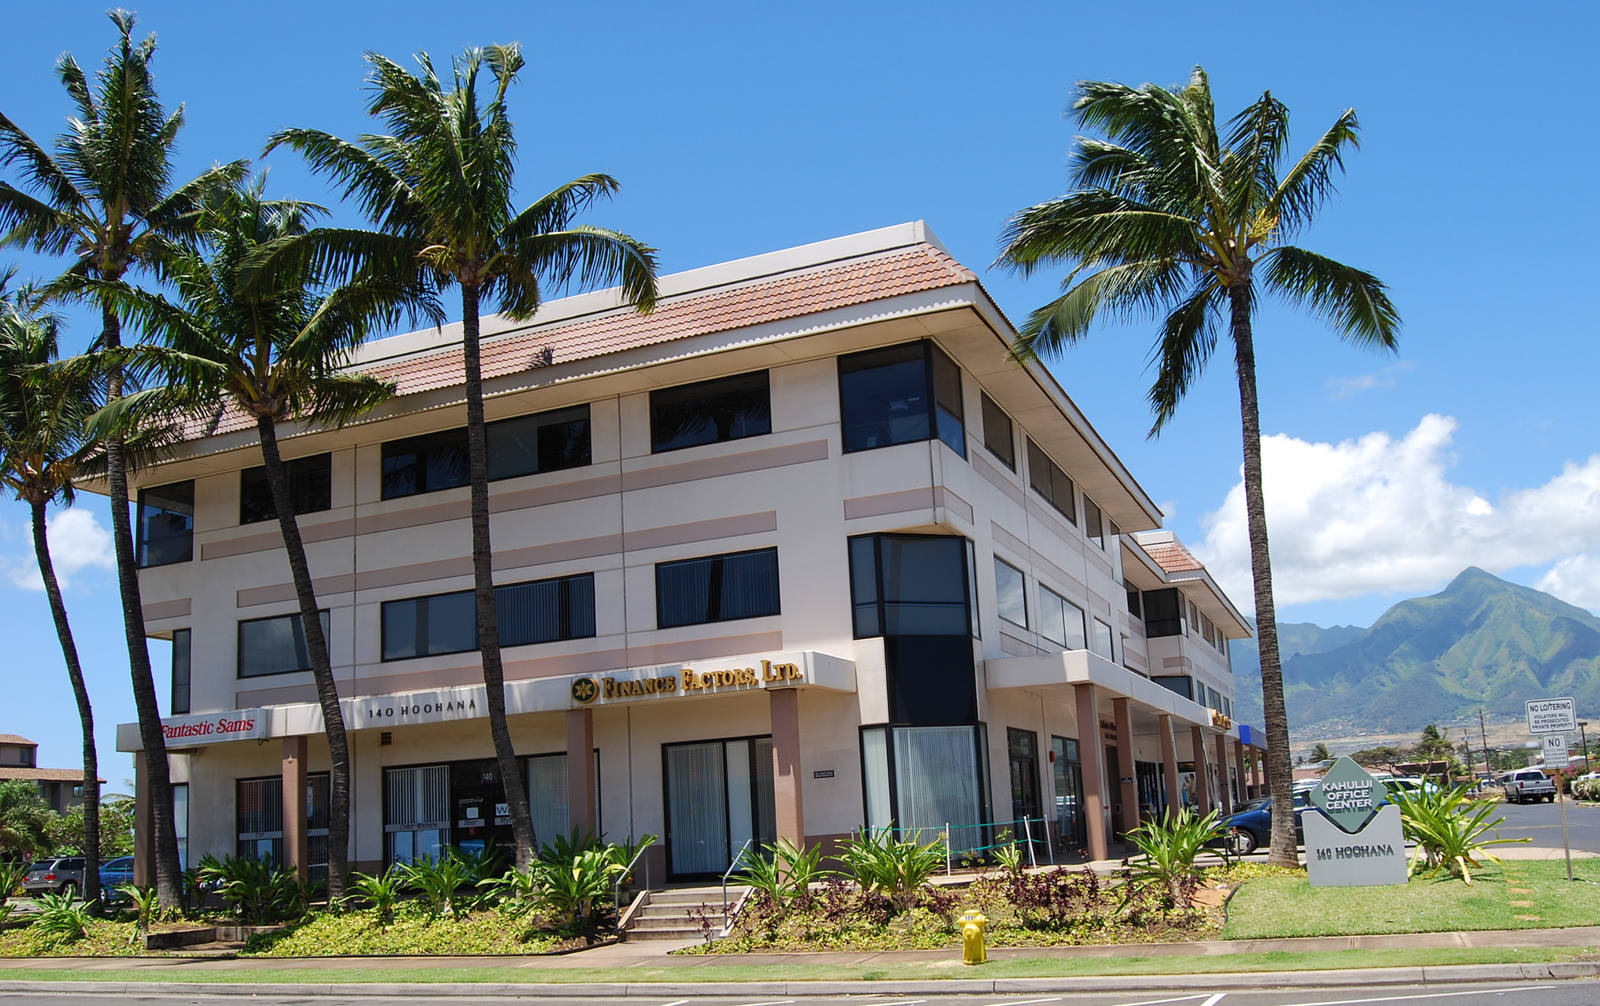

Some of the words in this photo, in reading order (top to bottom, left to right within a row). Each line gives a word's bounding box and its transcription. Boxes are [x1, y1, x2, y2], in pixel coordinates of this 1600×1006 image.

[601, 676, 677, 699] FINANCE
[679, 668, 759, 690] FACTORS,
[369, 707, 394, 718] 140
[401, 699, 476, 716] HOOHANA
[1529, 704, 1539, 712] NO
[1540, 702, 1571, 711] LOITERING
[161, 720, 215, 738] Fantastic
[215, 718, 255, 734] Sams
[1548, 738, 1560, 747] NO
[1322, 780, 1373, 792] KAHULUI
[1327, 789, 1370, 801] OFFICE
[1326, 798, 1372, 810] CENTER
[1316, 847, 1332, 860] 140
[1335, 844, 1394, 860] HOOHANA
